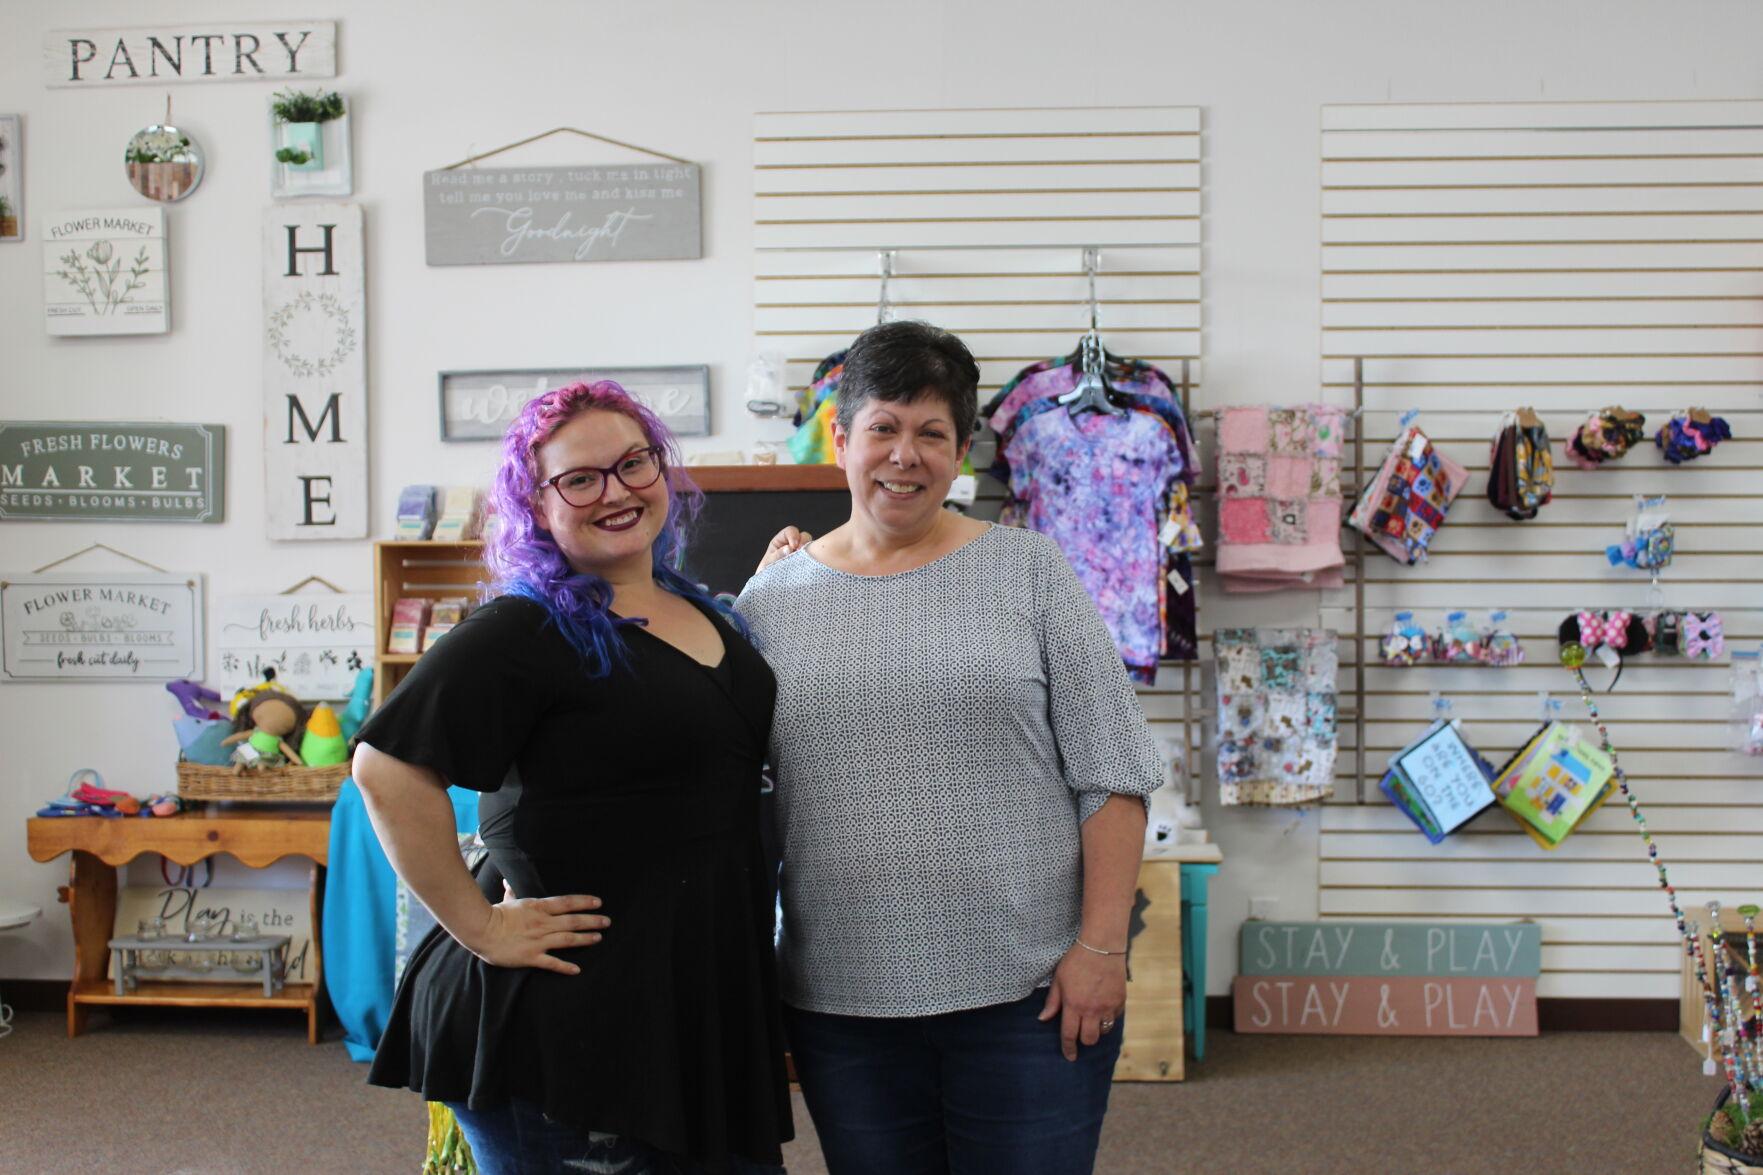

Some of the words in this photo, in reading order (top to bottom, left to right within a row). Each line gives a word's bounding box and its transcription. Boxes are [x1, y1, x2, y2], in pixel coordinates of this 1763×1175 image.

[67, 31, 312, 81] PANTRY
[51, 217, 101, 238] FLOWER
[104, 217, 154, 236] MARKET
[470, 206, 653, 260] Goodnight
[20, 435, 83, 458] FRESH
[90, 434, 183, 460] FLOWERS
[1, 465, 203, 490] MARKET
[1, 494, 53, 507] SEEDS
[69, 496, 135, 508] BLOOMS
[152, 496, 205, 509] BULBS
[24, 589, 92, 615] FLOWER
[100, 588, 172, 615] MARKET
[259, 604, 302, 641] fresh
[308, 604, 354, 632] herbs
[57, 651, 85, 669] fresh
[88, 651, 107, 665] cut
[109, 651, 140, 673] daily
[158, 887, 230, 935] Play
[263, 910, 294, 927] the
[1256, 926, 1354, 970] STAY
[1379, 928, 1401, 971] &
[1427, 927, 1523, 973] PLAY
[1251, 981, 1349, 1027] STAY
[1376, 983, 1397, 1029] &
[1424, 982, 1521, 1028] PLAY
